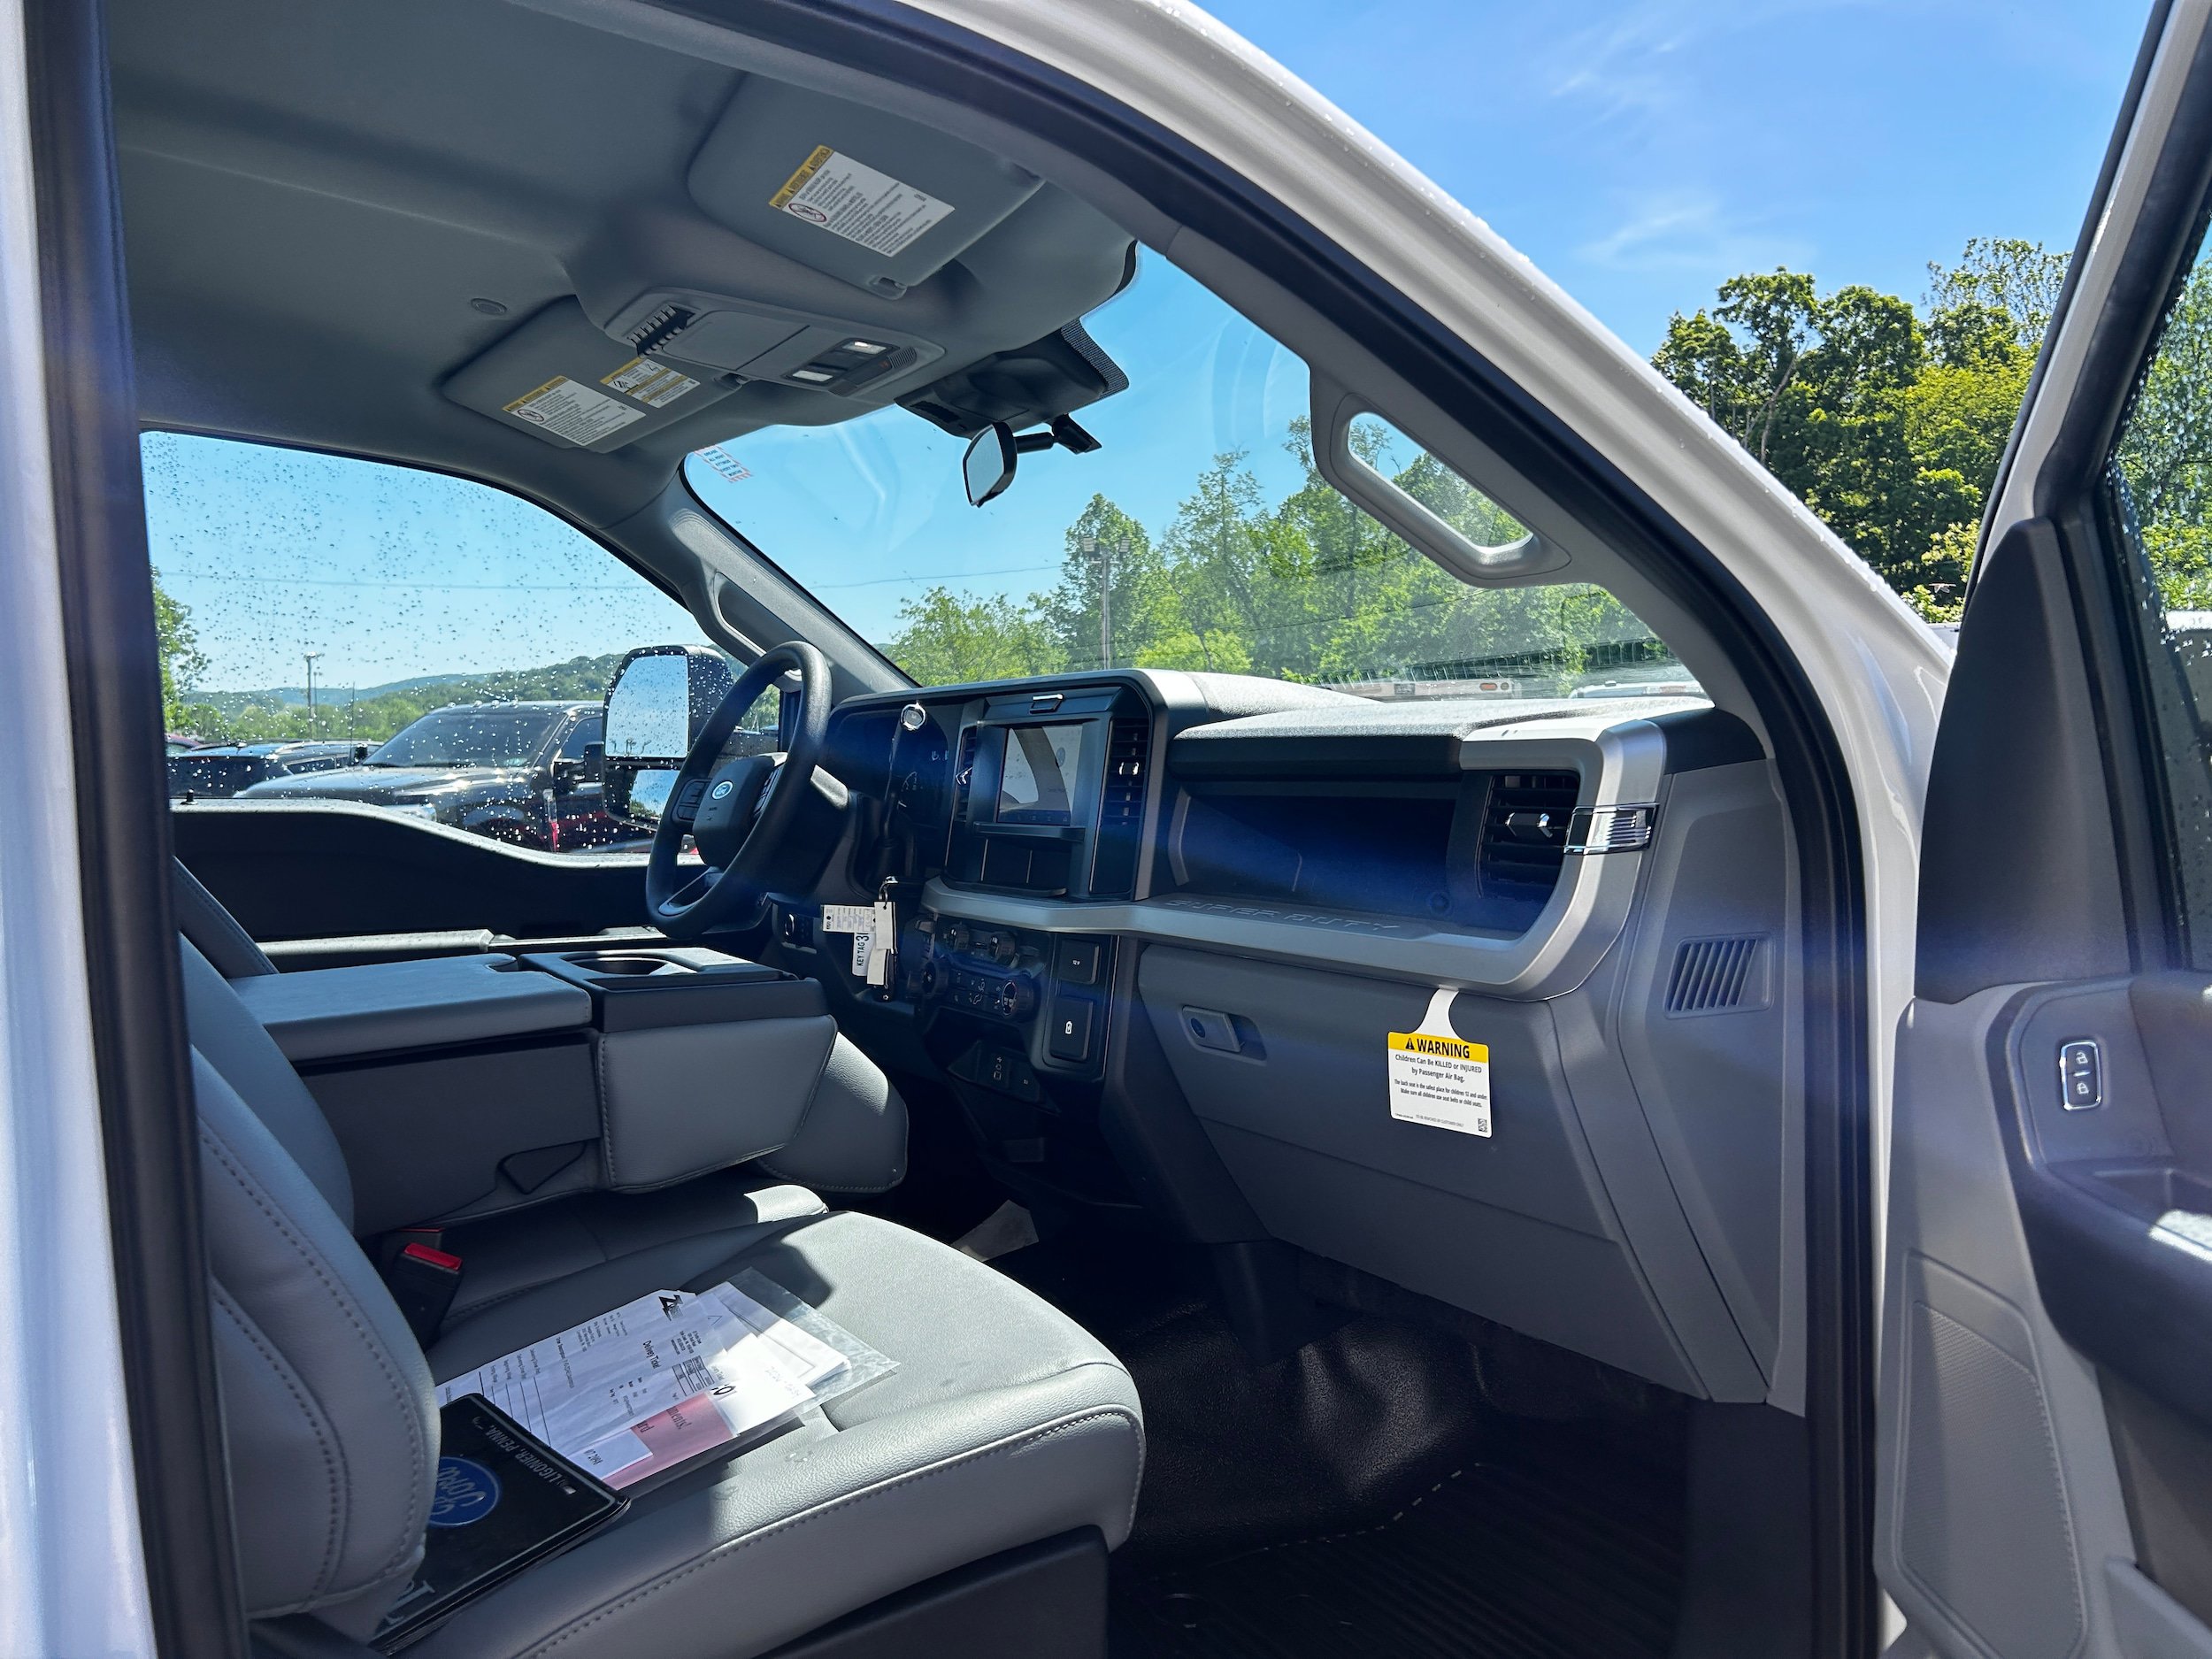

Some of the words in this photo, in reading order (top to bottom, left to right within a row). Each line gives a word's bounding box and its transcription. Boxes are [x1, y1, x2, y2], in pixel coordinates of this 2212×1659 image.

[1165, 900, 1281, 918] SUPER
[1284, 913, 1401, 931] DUTY
[856, 932, 870, 941] 3
[1417, 1038, 1469, 1059] WARNING
[1395, 1054, 1416, 1063] Children
[1435, 1060, 1452, 1068] KILLED
[1460, 1064, 1482, 1073] INJURED
[1412, 1067, 1418, 1075] by
[1419, 1068, 1444, 1079] Passenger
[642, 1340, 656, 1358] Delivery
[649, 1355, 661, 1369] Ticket
[486, 1425, 519, 1453] PENNA.
[515, 1448, 563, 1483] LIGONIER,
